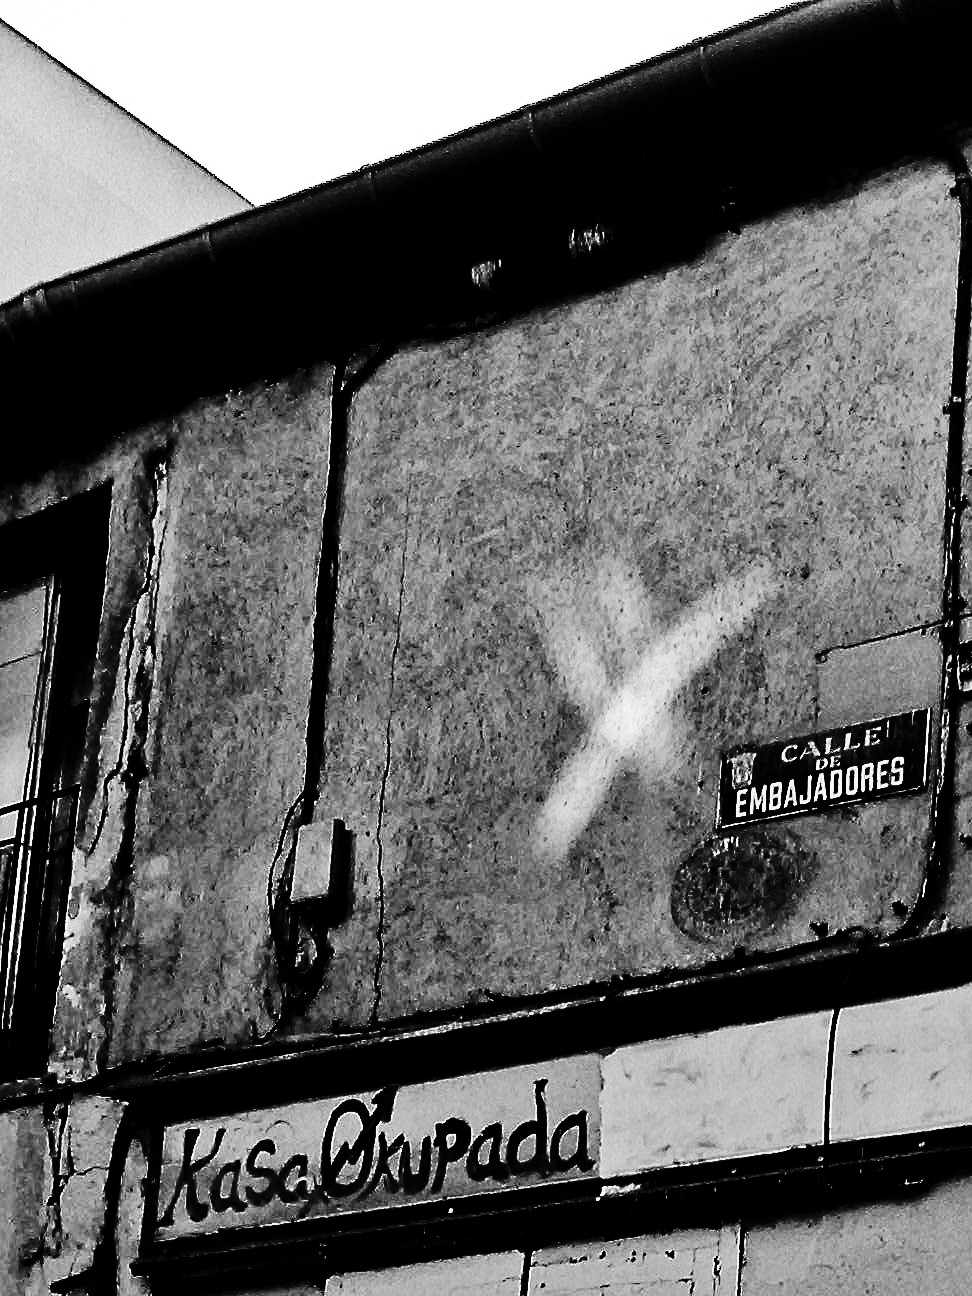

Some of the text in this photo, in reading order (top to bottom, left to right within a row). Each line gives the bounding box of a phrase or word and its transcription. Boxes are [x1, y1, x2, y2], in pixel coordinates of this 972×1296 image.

[780, 725, 883, 764] CALLE
[815, 754, 842, 772] DE
[734, 755, 906, 819] EMBAJADORES
